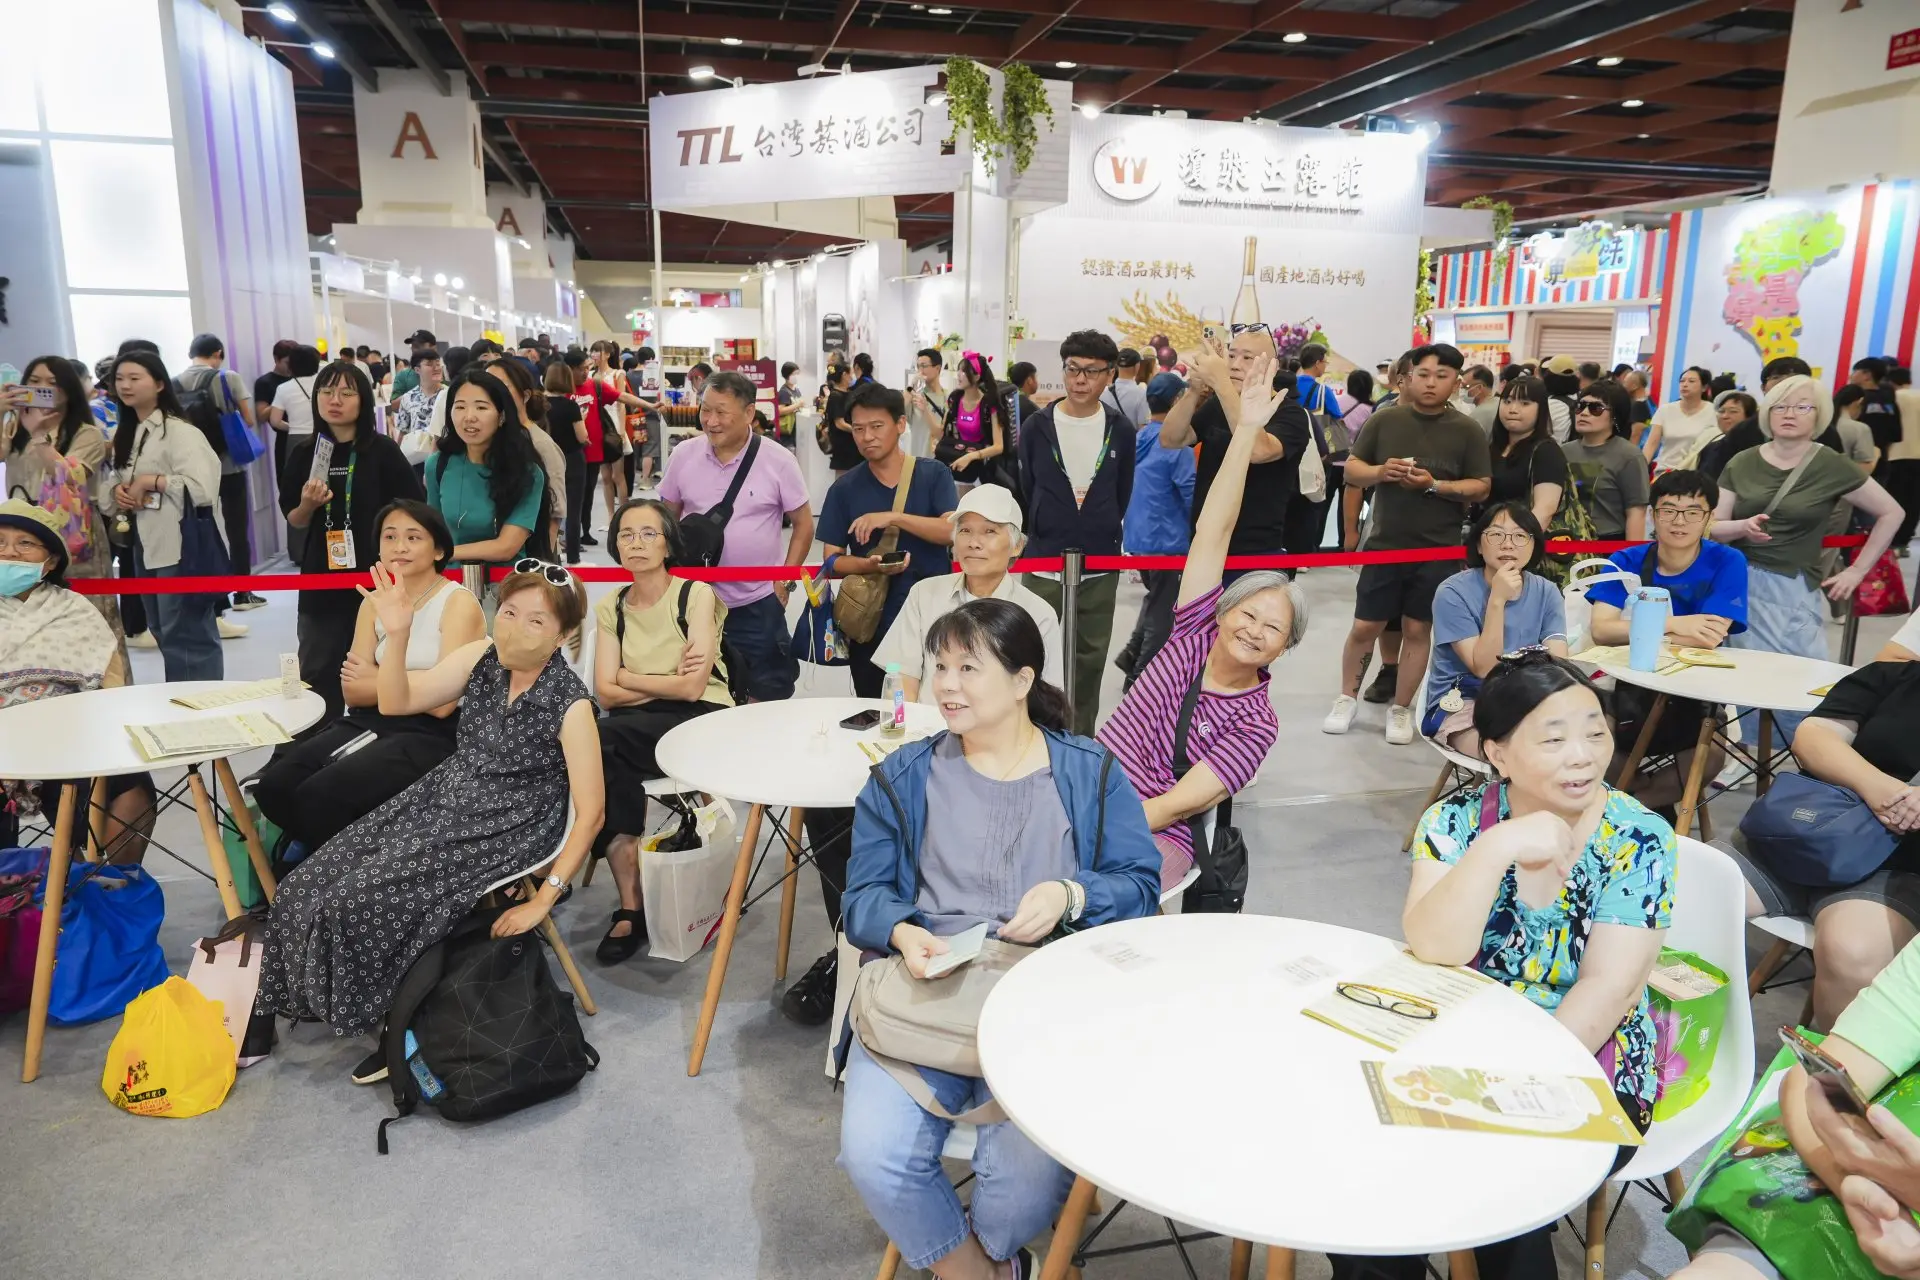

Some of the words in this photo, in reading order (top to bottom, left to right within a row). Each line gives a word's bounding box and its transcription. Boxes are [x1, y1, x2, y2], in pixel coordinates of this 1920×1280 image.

[391, 112, 438, 160] A
[677, 125, 743, 166] TTL
[497, 208, 523, 236] A
[1081, 258, 1196, 279] 認證酒品最對味
[1259, 265, 1366, 287] 國產地酒尚好喝
